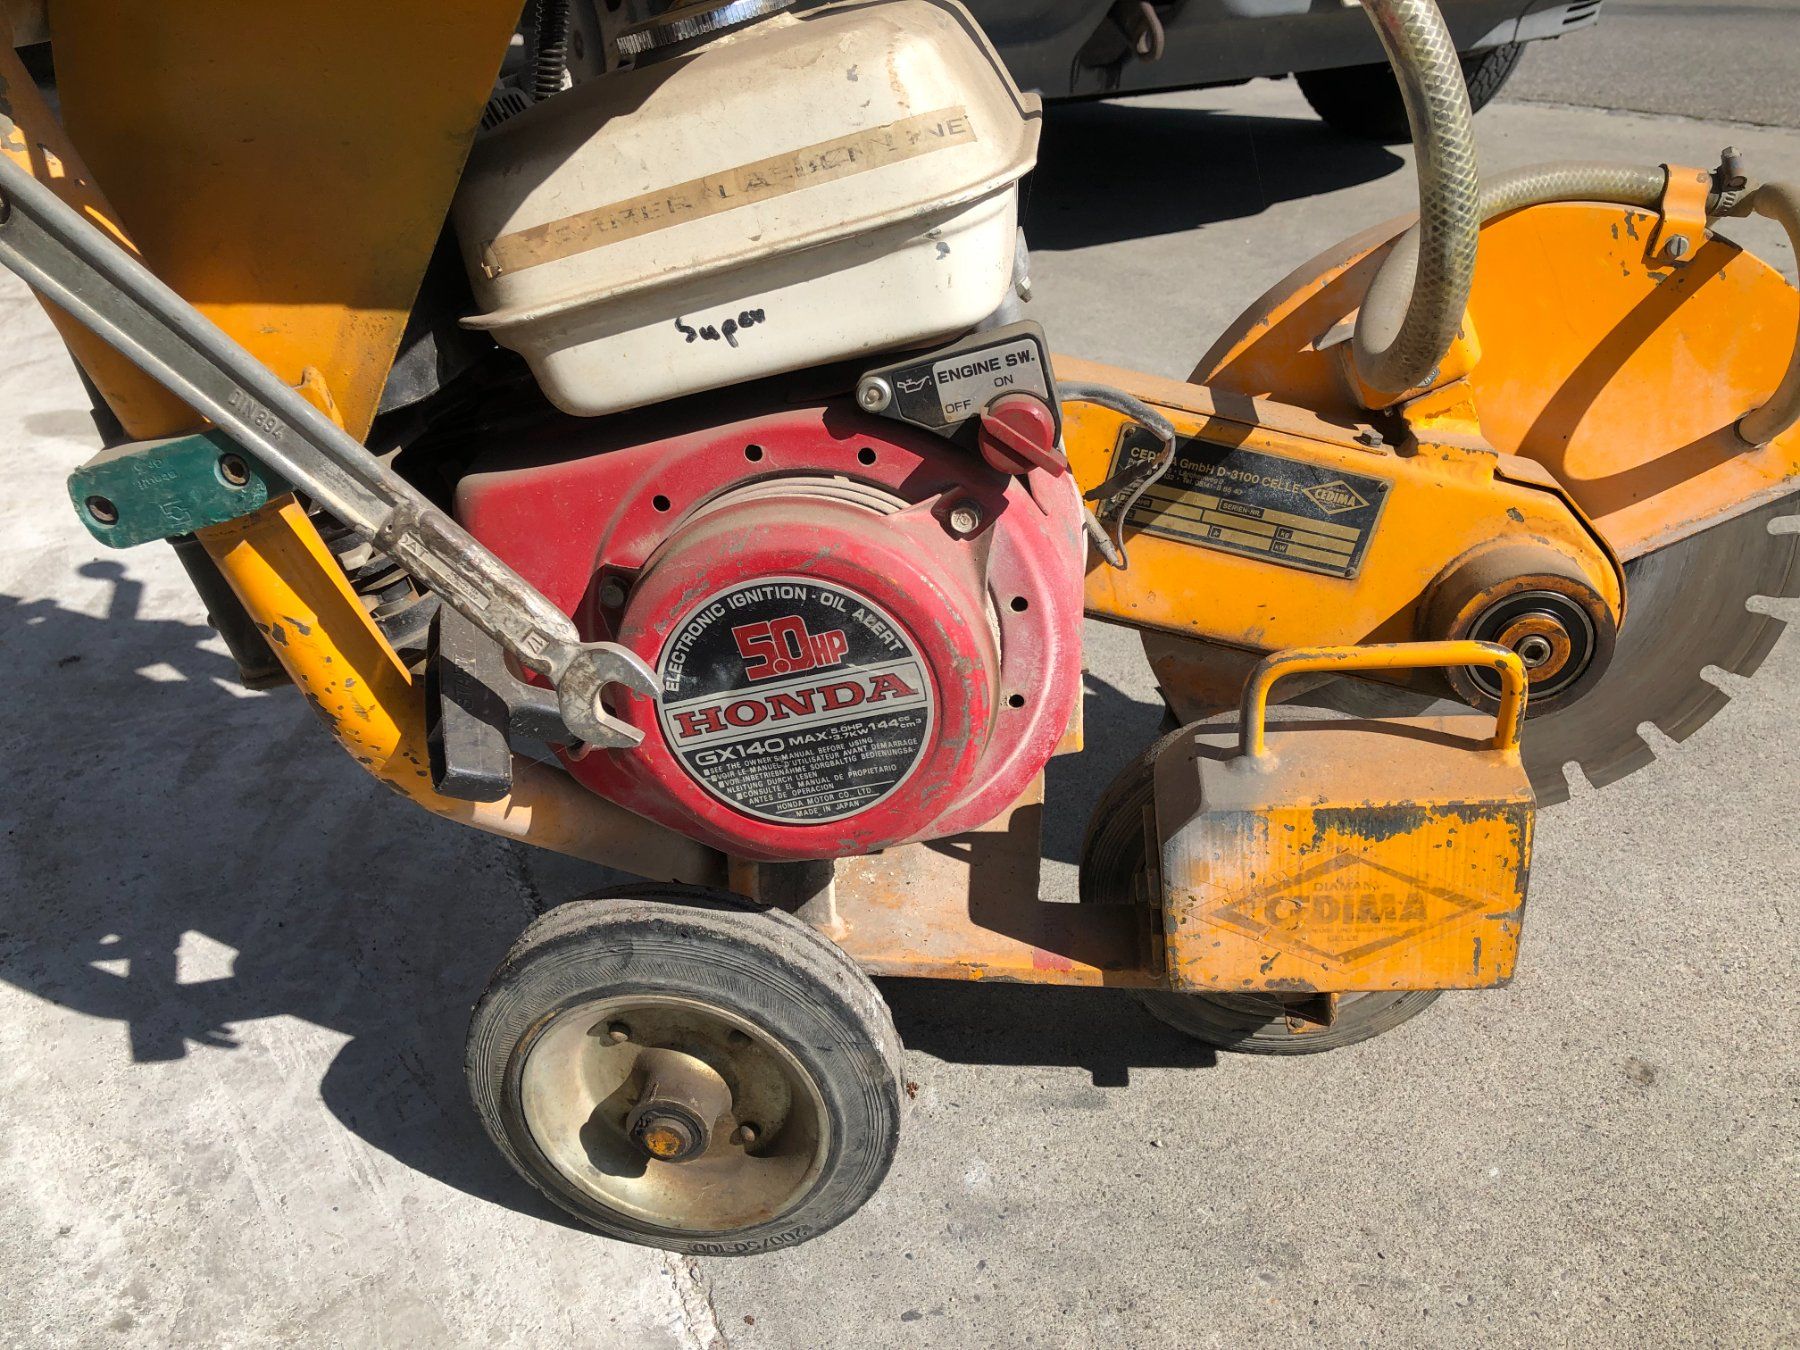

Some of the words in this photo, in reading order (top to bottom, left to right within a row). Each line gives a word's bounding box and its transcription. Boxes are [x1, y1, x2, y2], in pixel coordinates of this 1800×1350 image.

[937, 358, 1001, 384] ENGINE
[1005, 350, 1035, 366] SW.
[994, 374, 1013, 387] ON
[945, 400, 971, 414] OFF
[1130, 447, 1177, 467] CEDA
[1180, 458, 1214, 475] GmbH
[1217, 465, 1260, 485] D-3100
[1262, 476, 1302, 494] CELLE
[1314, 489, 1356, 507] CEDIMA
[524, 635, 543, 653] 17
[665, 603, 726, 691] ELECTRONIC
[727, 586, 807, 610] IGNITION
[820, 592, 847, 613] OIL
[852, 608, 904, 651] ALERT
[675, 673, 919, 735] HONDA
[695, 739, 785, 766] GX140
[788, 730, 832, 746] MAX.
[830, 722, 863, 734] 5.0HP
[867, 717, 899, 732] 144
[709, 766, 723, 774] SEE
[726, 761, 741, 770] THE
[744, 754, 778, 767] OWNER'S
[780, 748, 814, 761] MANUAL
[817, 742, 845, 753] BEFORE
[848, 736, 873, 747] USING
[716, 771, 734, 779] VOIR
[749, 762, 781, 773] MANUEL
[842, 746, 867, 756] AVANT
[726, 780, 763, 793] NLEITUNG
[767, 775, 792, 786] DURCH
[795, 770, 817, 780] LESEN
[742, 784, 780, 797] CONSULTE
[797, 776, 830, 787] MANUAL
[847, 763, 896, 779] PROPIETARIO
[748, 794, 773, 804] ANTES
[791, 782, 834, 796] OPERACION
[776, 799, 803, 810] HONDA
[806, 793, 834, 804] MOTOR
[796, 808, 819, 817] MADE
[835, 800, 860, 811] JAPAN
[692, 1225, 807, 1254] 200/50-100
